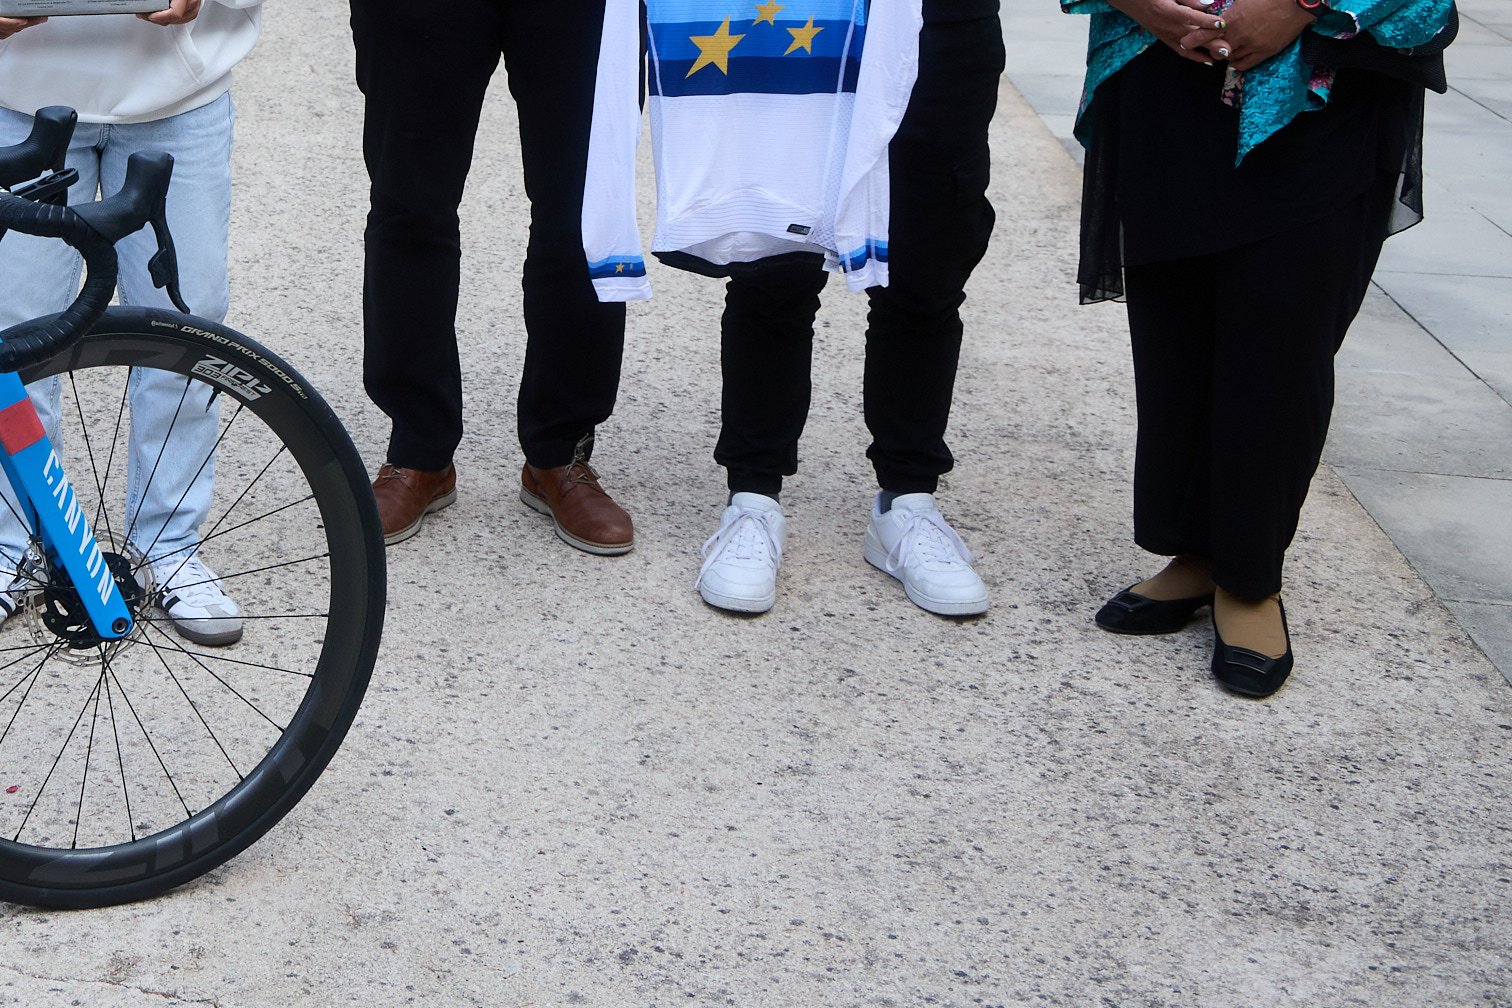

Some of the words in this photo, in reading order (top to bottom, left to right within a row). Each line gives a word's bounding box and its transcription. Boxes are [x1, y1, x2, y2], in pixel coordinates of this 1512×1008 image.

[180, 325, 230, 345] GRAND
[227, 342, 261, 360] PRIX
[258, 358, 295, 384] 5000
[193, 365, 221, 379] 303
[198, 354, 273, 394] ZIPP
[43, 448, 115, 607] CANYON
